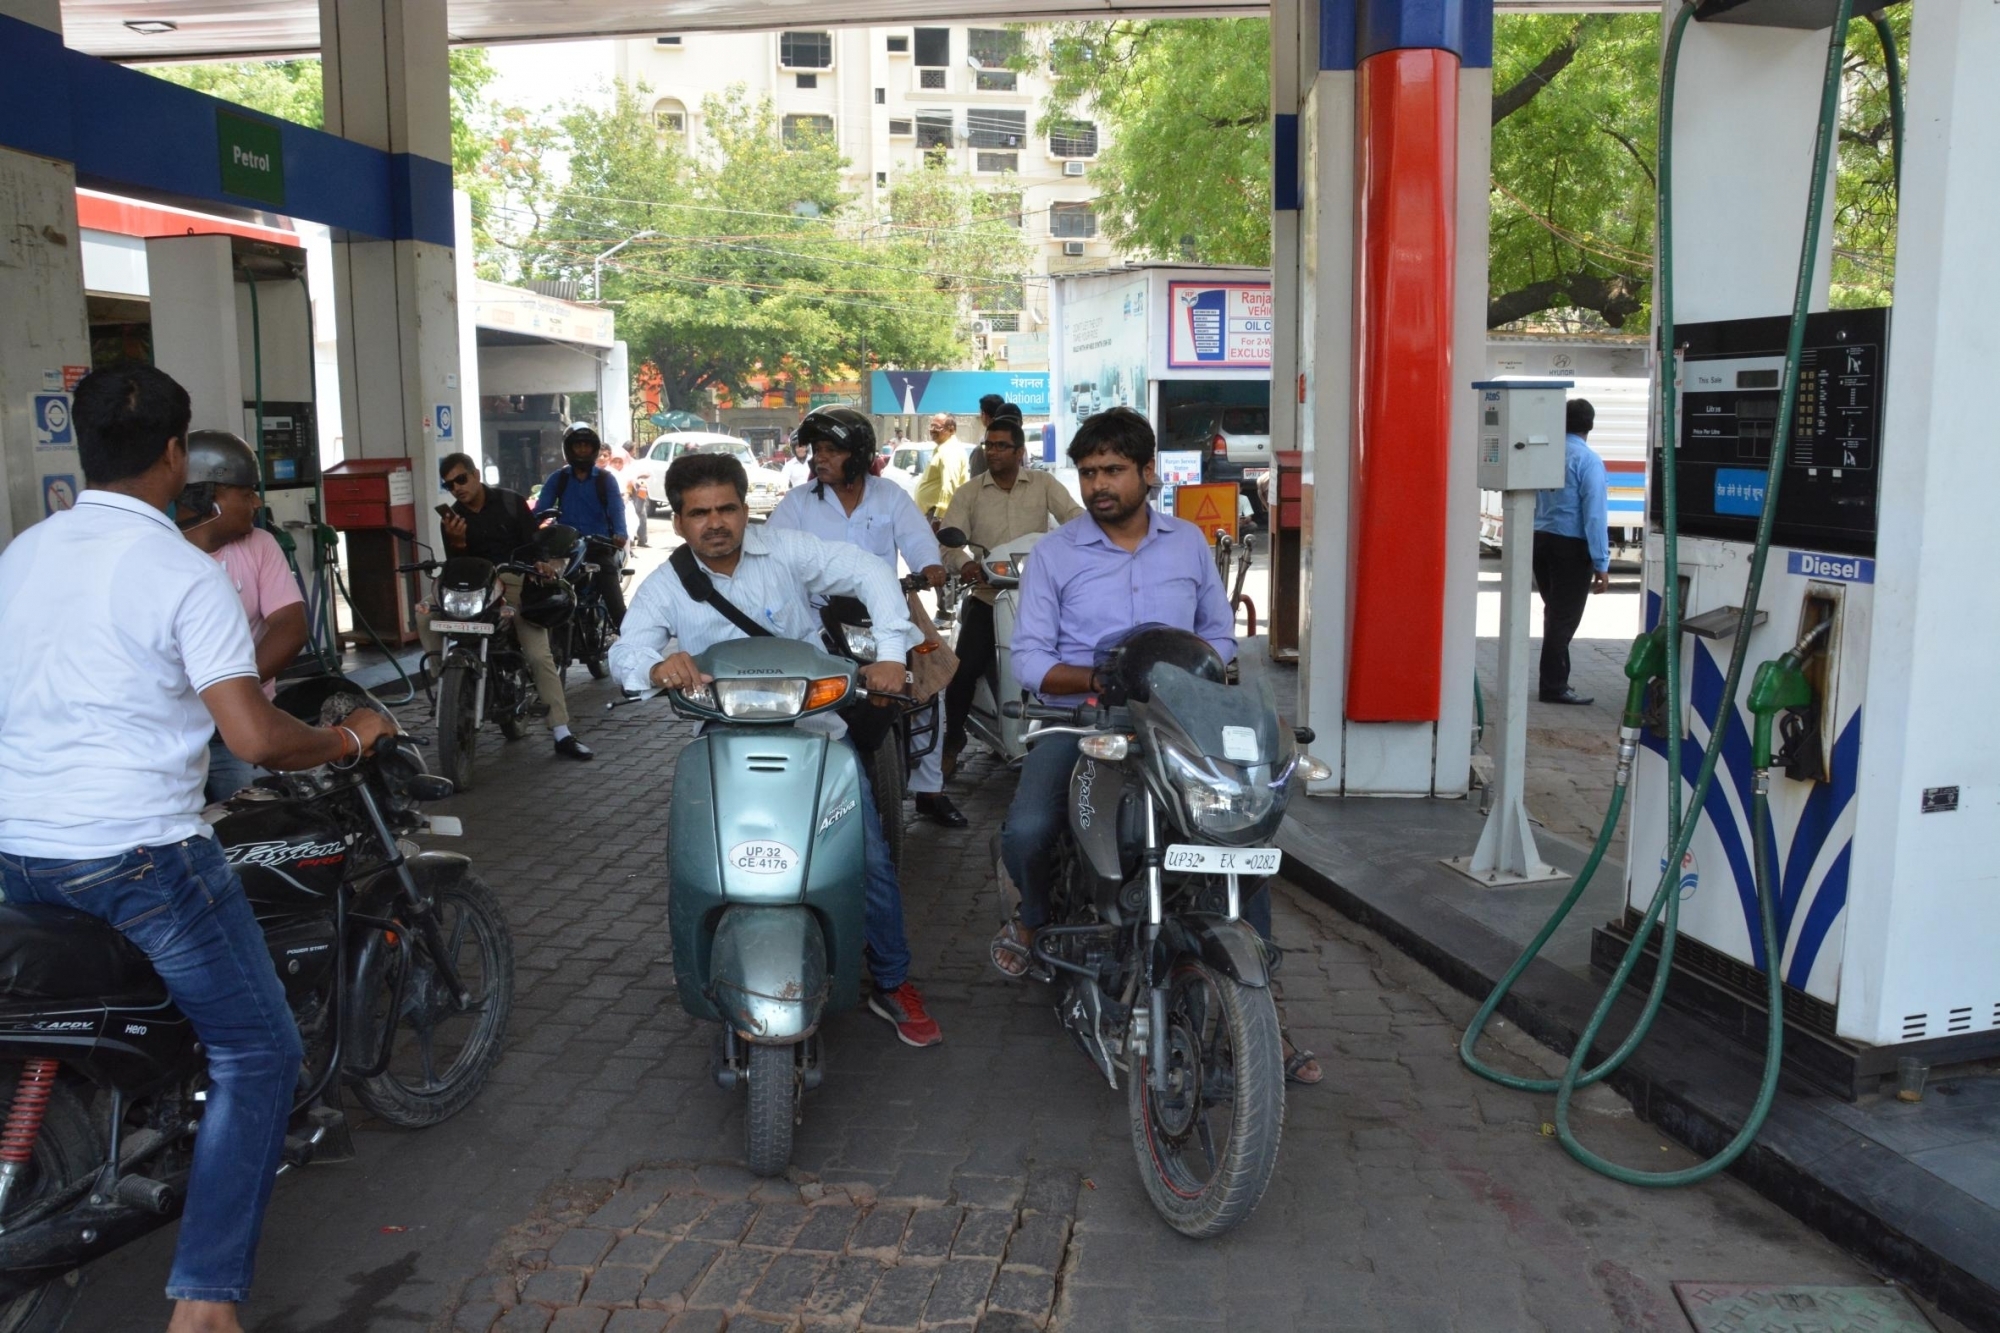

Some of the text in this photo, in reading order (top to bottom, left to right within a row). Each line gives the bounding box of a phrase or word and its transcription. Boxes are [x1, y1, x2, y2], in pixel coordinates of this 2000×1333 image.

[233, 145, 270, 172] Petrol
[1248, 307, 1271, 316] VEHI
[1245, 321, 1261, 330] OIL
[1005, 391, 1044, 404] National
[1802, 555, 1860, 579] Diesel
[818, 800, 857, 836] Activa
[222, 841, 345, 866] Passion
[297, 855, 345, 868] PRO
[1168, 851, 1276, 870] UP32 EX 0282
[309, 944, 329, 953] START
[125, 1024, 148, 1036] Hero
